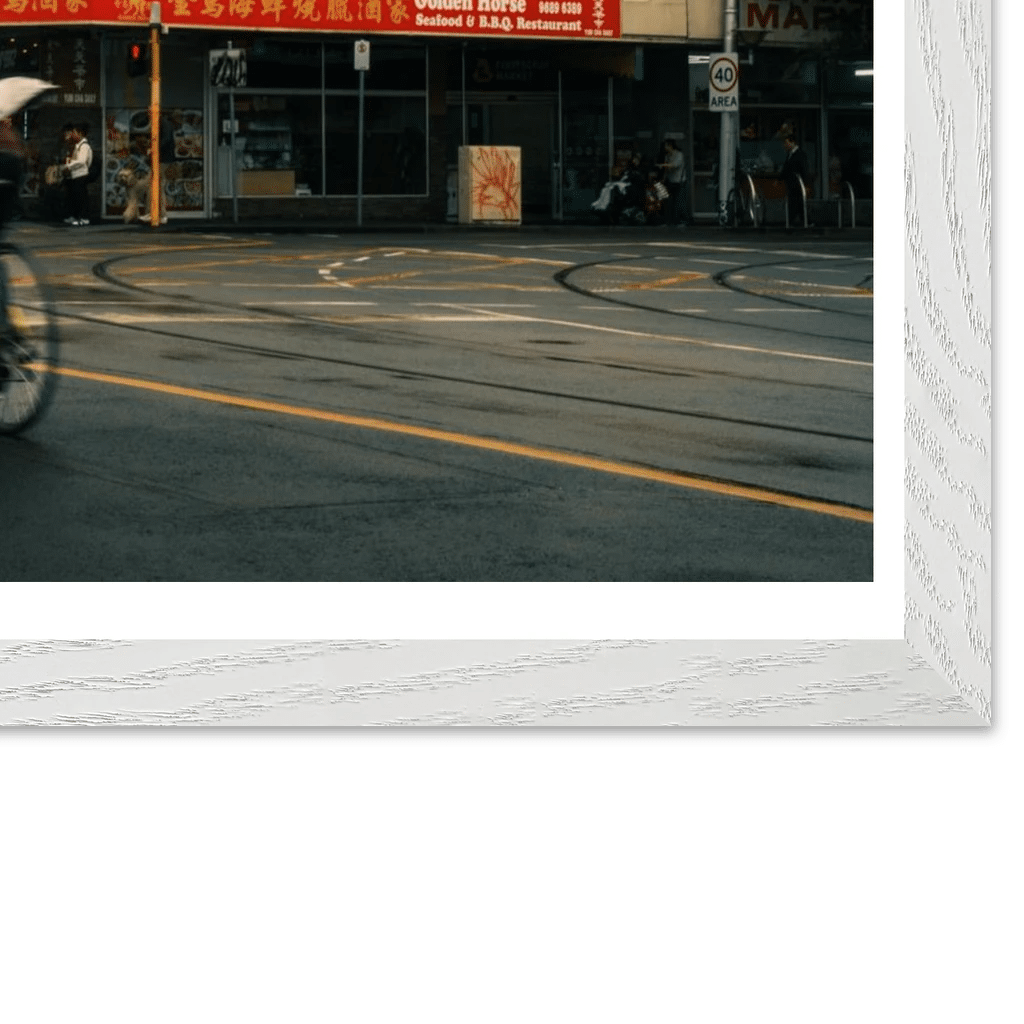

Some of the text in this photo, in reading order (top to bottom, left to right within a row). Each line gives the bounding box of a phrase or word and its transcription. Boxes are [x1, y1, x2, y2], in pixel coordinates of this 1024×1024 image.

[415, 13, 583, 32] Seafood & B.B.Q. Restaurant
[714, 67, 734, 83] 40
[710, 96, 737, 107] AREA
